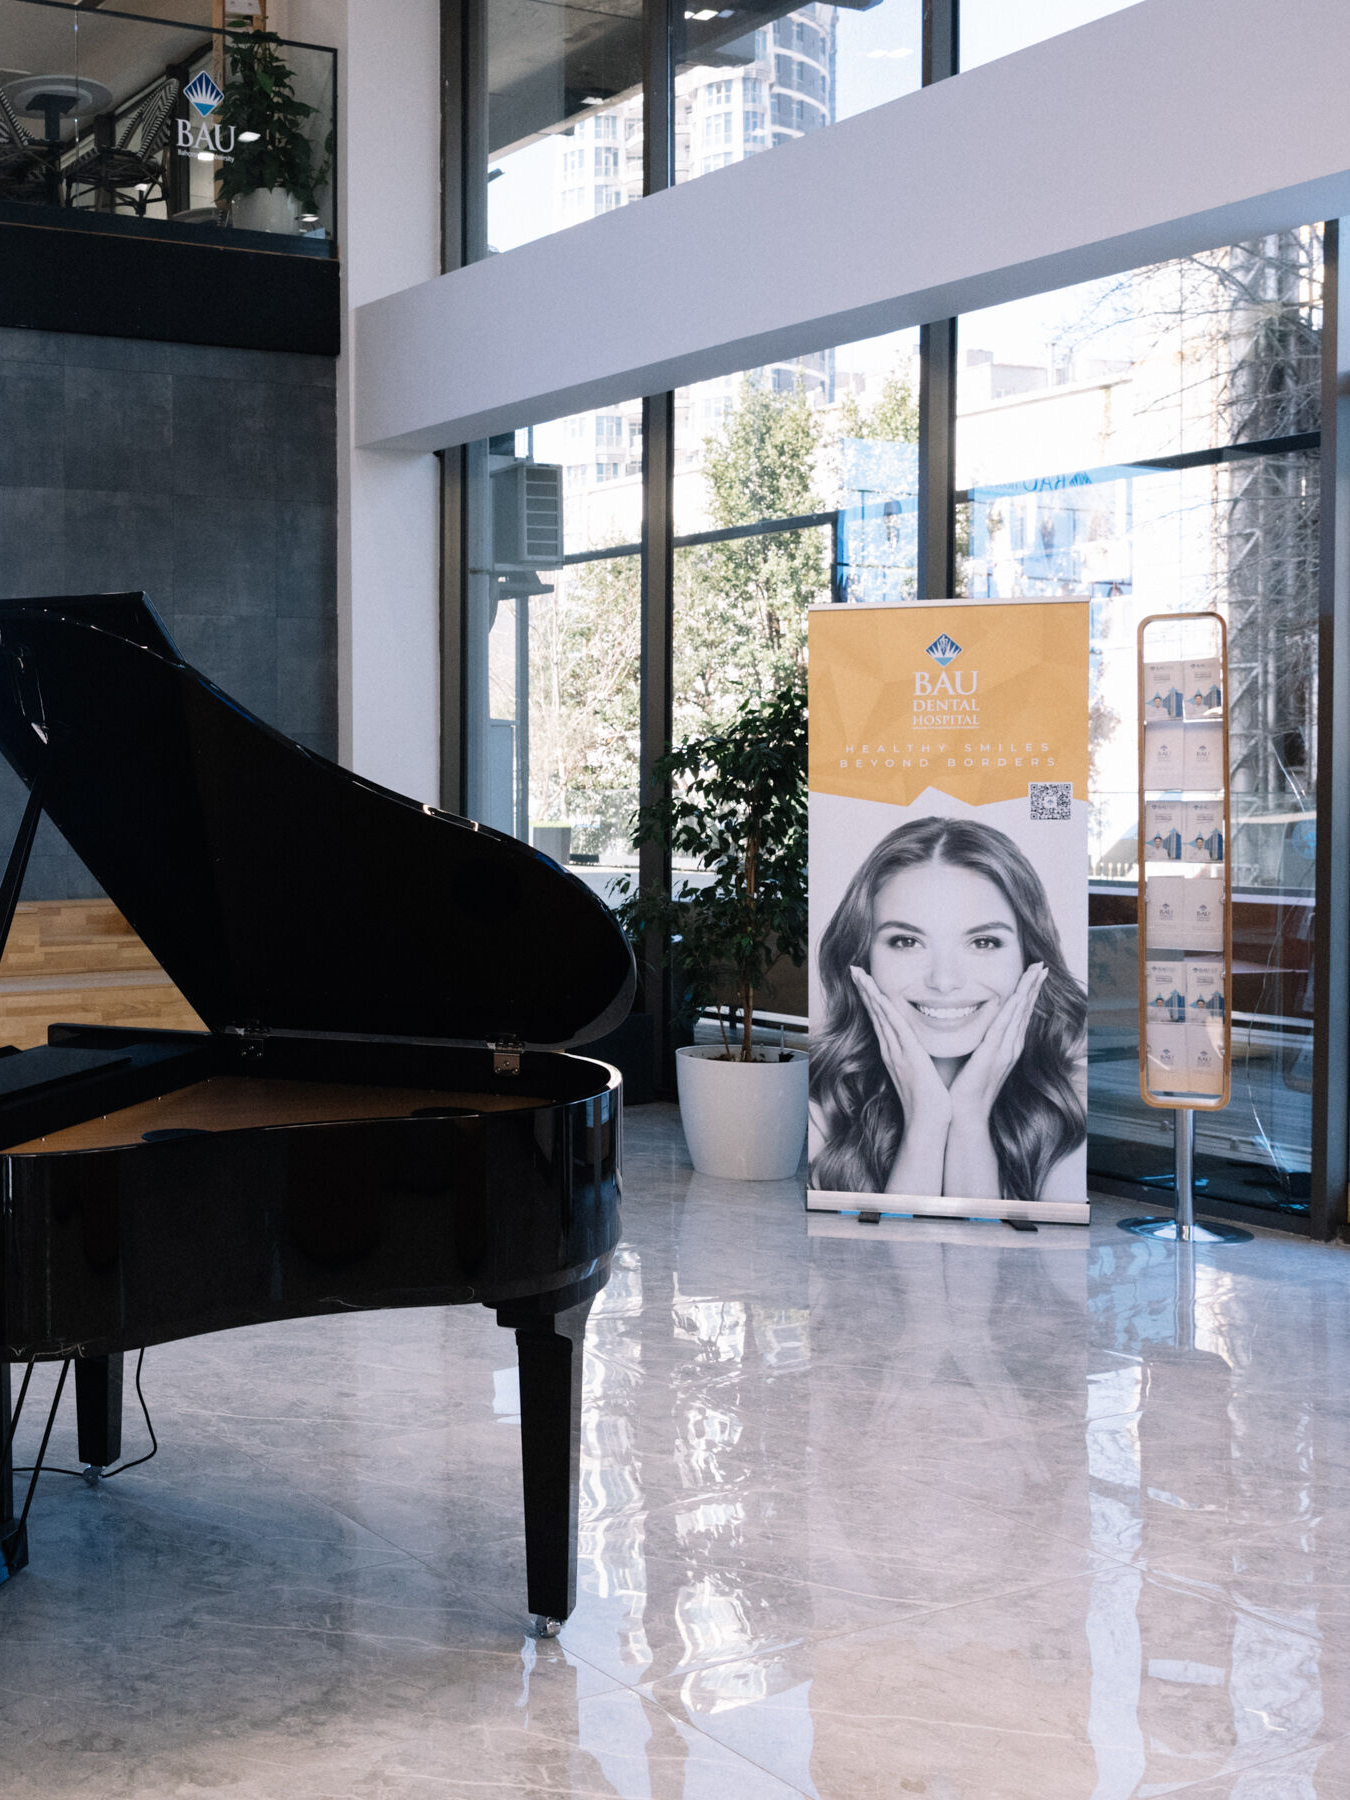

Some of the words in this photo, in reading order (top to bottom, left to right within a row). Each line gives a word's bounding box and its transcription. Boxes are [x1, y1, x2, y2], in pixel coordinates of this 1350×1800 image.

[175, 118, 236, 153] BAU
[913, 670, 978, 696] BAU
[912, 698, 980, 713] DENTAL
[912, 714, 979, 727] HOSPITAL
[845, 743, 947, 754] HEALTHY
[964, 742, 1050, 752] SMILES
[839, 758, 929, 769] BEYOND
[947, 757, 1056, 768] BORDERS
